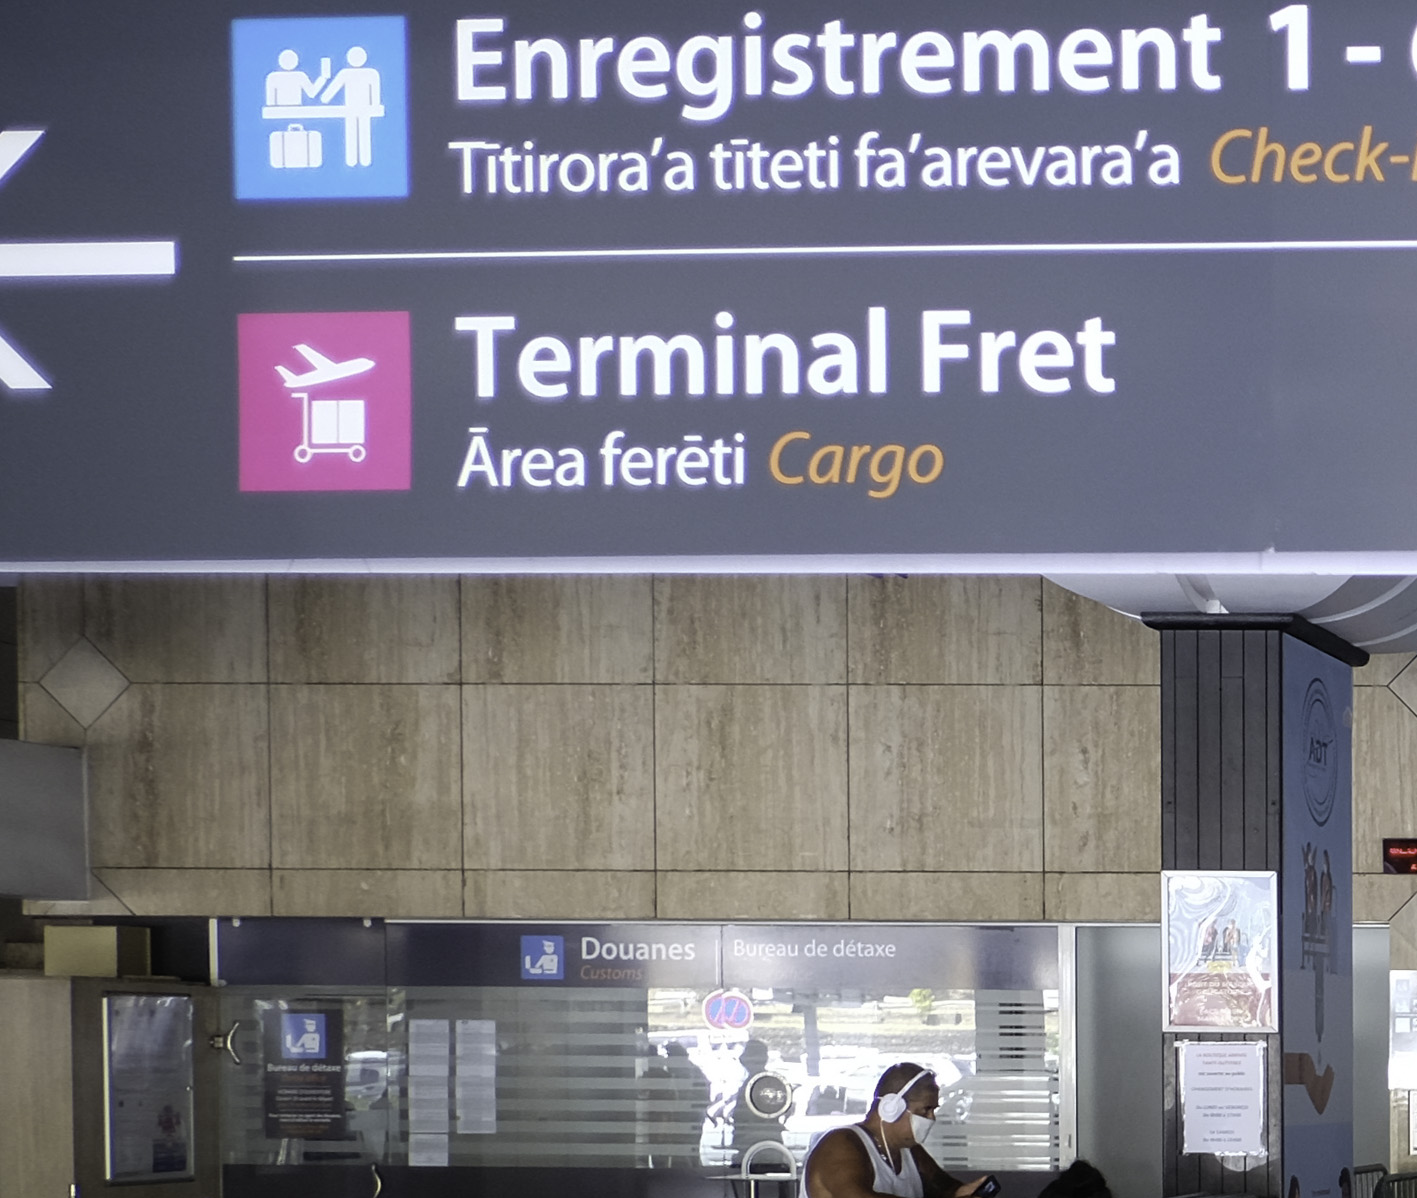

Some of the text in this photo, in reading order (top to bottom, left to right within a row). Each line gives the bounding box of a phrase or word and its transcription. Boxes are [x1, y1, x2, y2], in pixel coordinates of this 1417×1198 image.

[456, 11, 1222, 122] Enregistrement
[1269, 4, 1309, 91] 1
[454, 306, 1116, 399] Terminal Fret
[456, 426, 945, 499] Ārea ferēti Cargo
[580, 936, 897, 960] Douanes Bureau de détaxe
